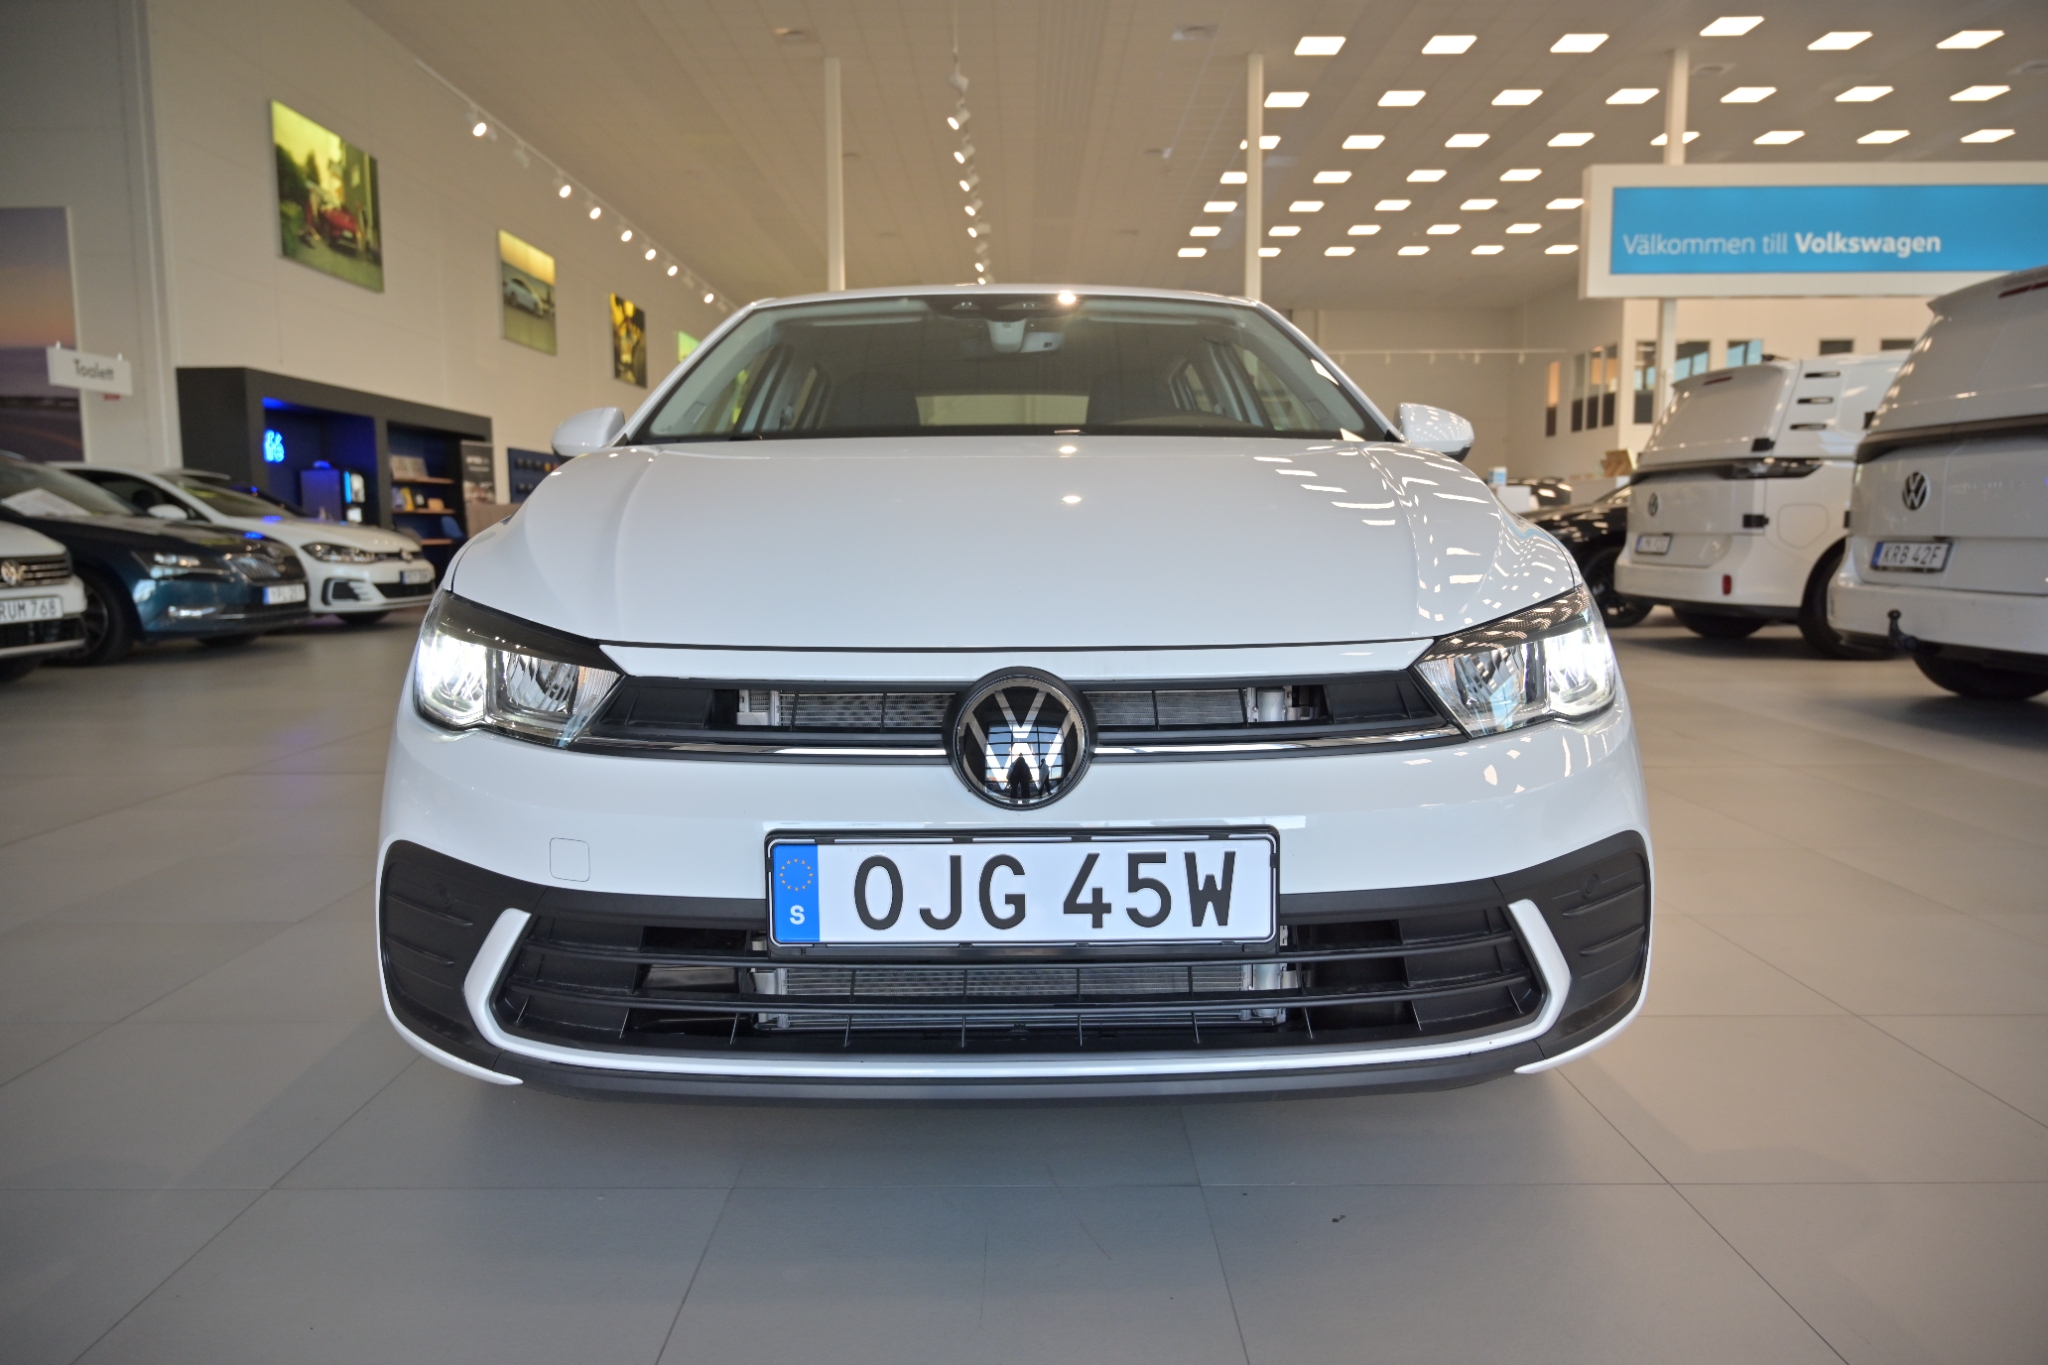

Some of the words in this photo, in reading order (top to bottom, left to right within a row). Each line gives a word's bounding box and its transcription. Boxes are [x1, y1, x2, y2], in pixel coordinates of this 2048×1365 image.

[1622, 232, 1756, 255] Välkommen
[1762, 231, 1788, 255] till
[1794, 231, 1941, 258] Volkswagen
[74, 358, 115, 381] Toalett
[962, 682, 1081, 800] VW
[854, 853, 1026, 931] OJG
[1063, 850, 1236, 928] 45W
[789, 904, 806, 925] S
